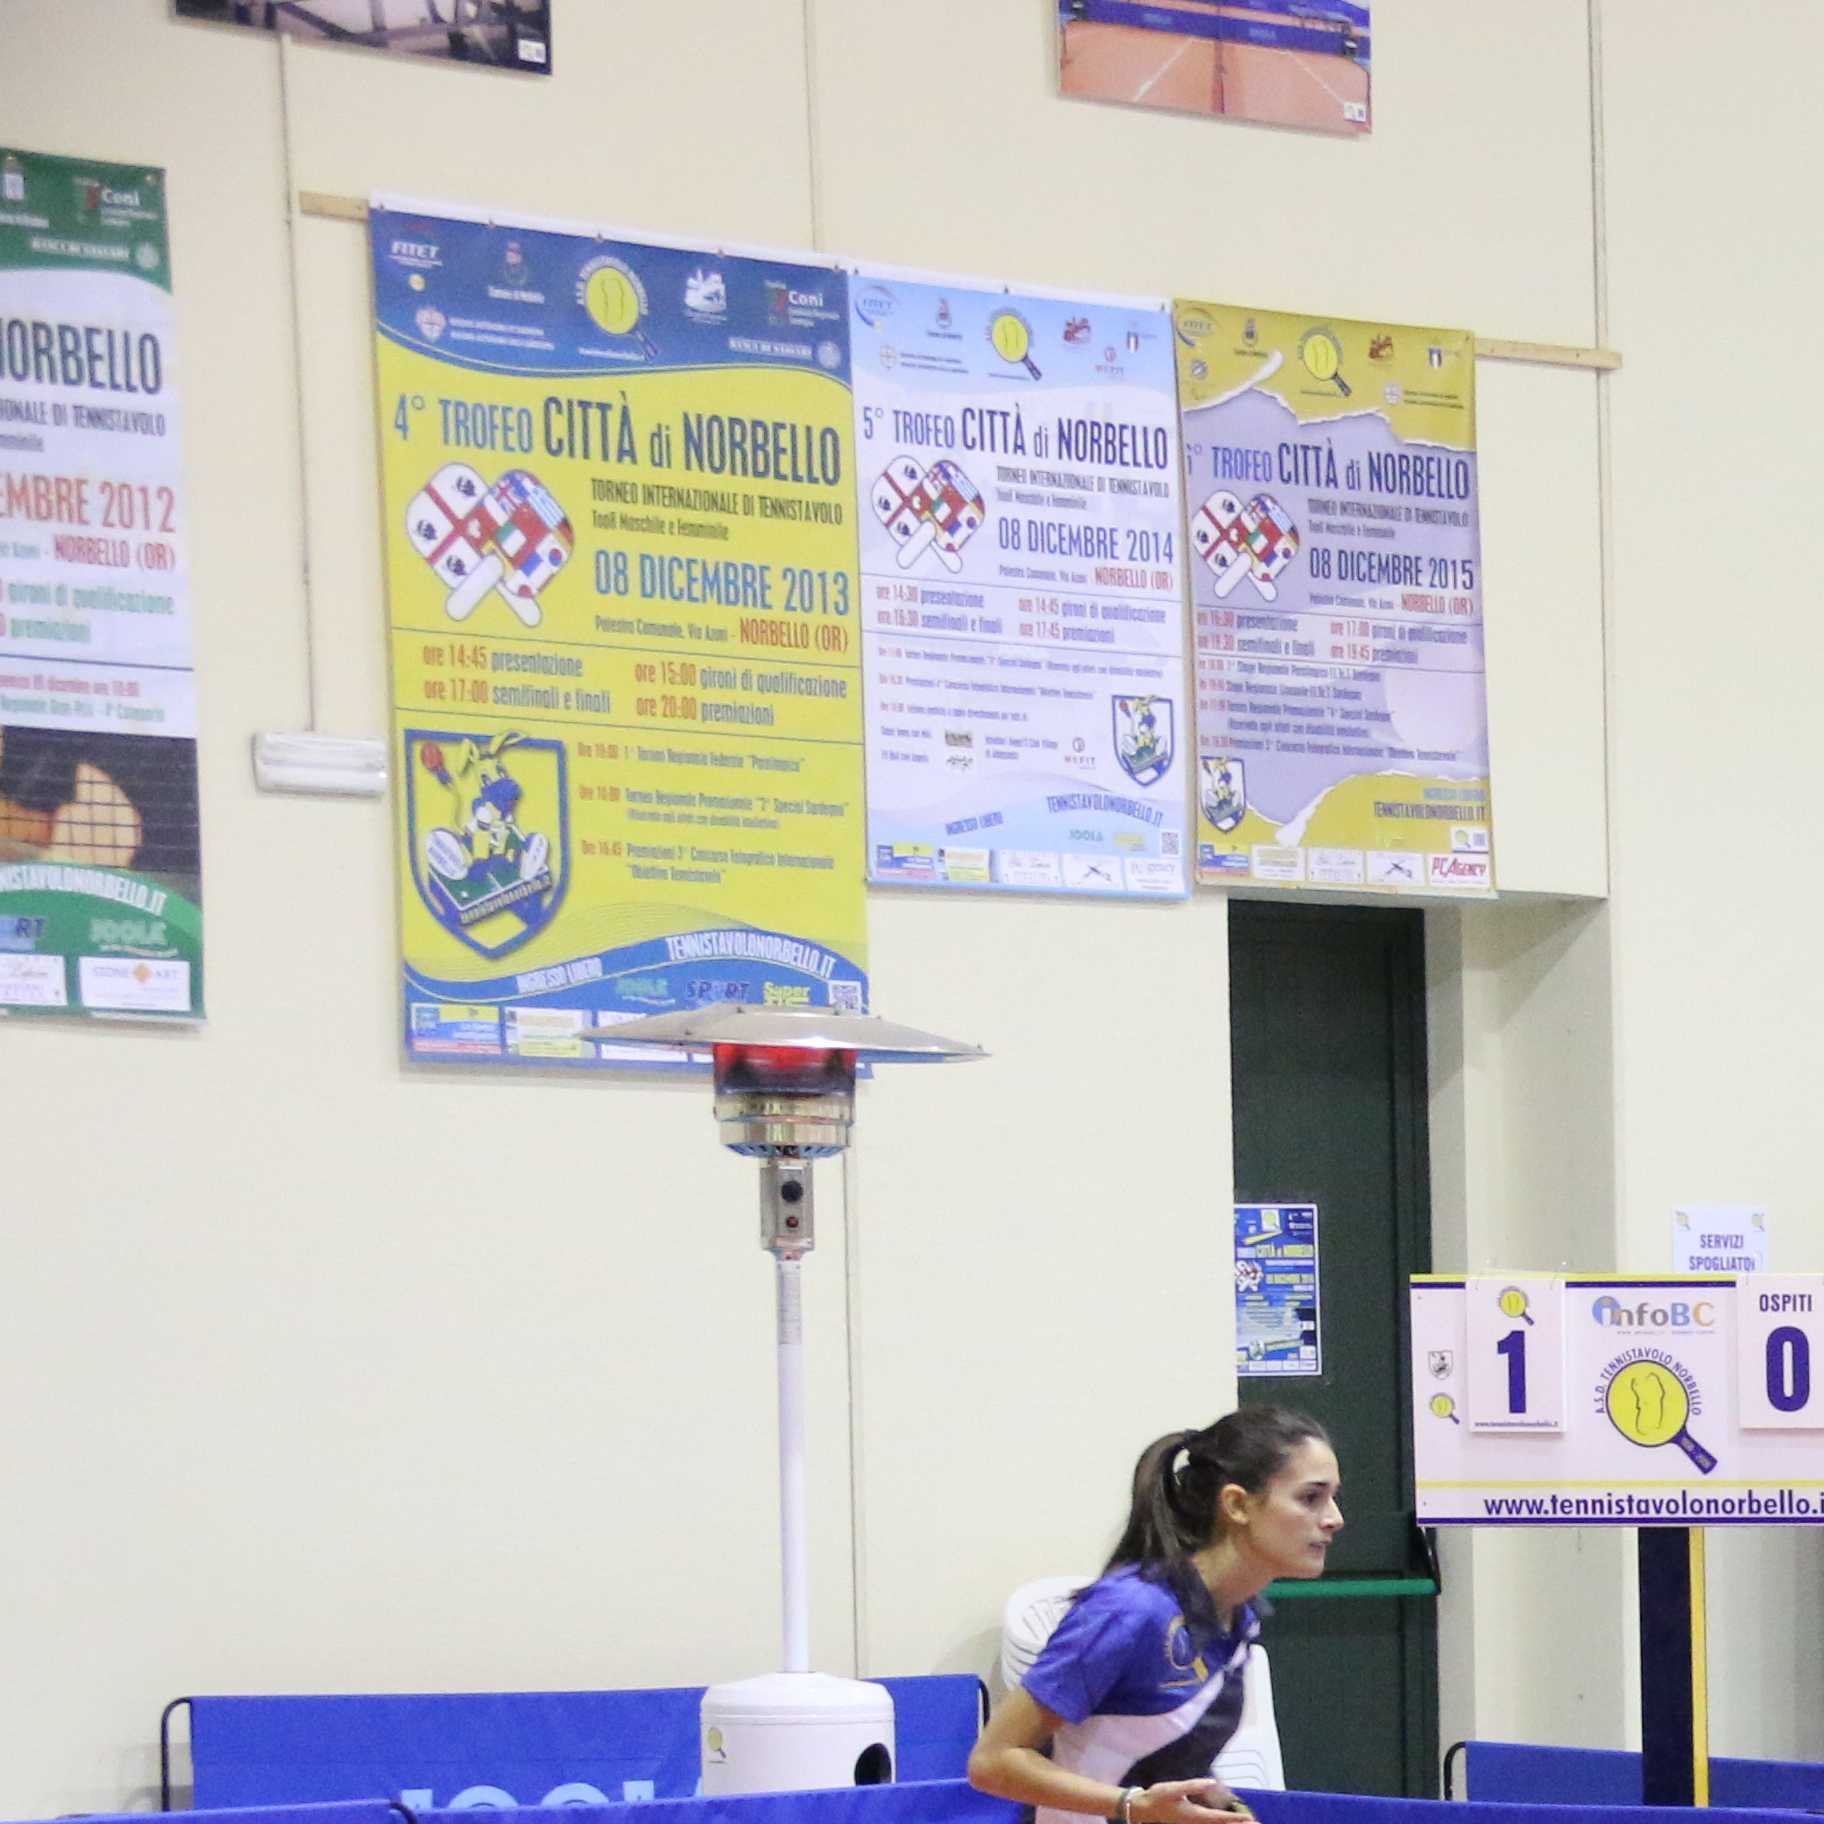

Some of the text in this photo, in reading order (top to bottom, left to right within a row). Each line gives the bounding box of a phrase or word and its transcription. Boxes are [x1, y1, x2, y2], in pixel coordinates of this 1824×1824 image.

[439, 399, 533, 453] TROFEO
[543, 391, 637, 465] CITTÀ
[650, 424, 672, 470] di
[682, 412, 840, 487] NORBELLO
[893, 409, 955, 449] TROFEO
[962, 402, 1026, 456] CITTÀ
[1033, 424, 1049, 459] di
[1058, 417, 1168, 469] NORBELLO
[1211, 437, 1469, 500] TROFEO CITTÀ di NORBELLO
[100, 480, 176, 533] 2012
[591, 478, 638, 506] TORNEO
[643, 484, 739, 515] INTERNAZIONALE
[758, 495, 843, 526] TENNISTAVOLO
[999, 517, 1173, 564] 08 DICEMBRE 2014
[595, 549, 849, 616] 08 DICEMBRE 2013
[1310, 547, 1474, 590] 08 DICEMBRE 2015
[740, 617, 809, 649] NORBELLO
[815, 626, 848, 652] (OR)
[757, 671, 847, 698] qualificazione
[1700, 1234, 1744, 1249] SERVIZI
[1759, 1294, 1813, 1313] OSPITI
[1496, 1330, 1526, 1414] 1
[1766, 1326, 1810, 1412] 0
